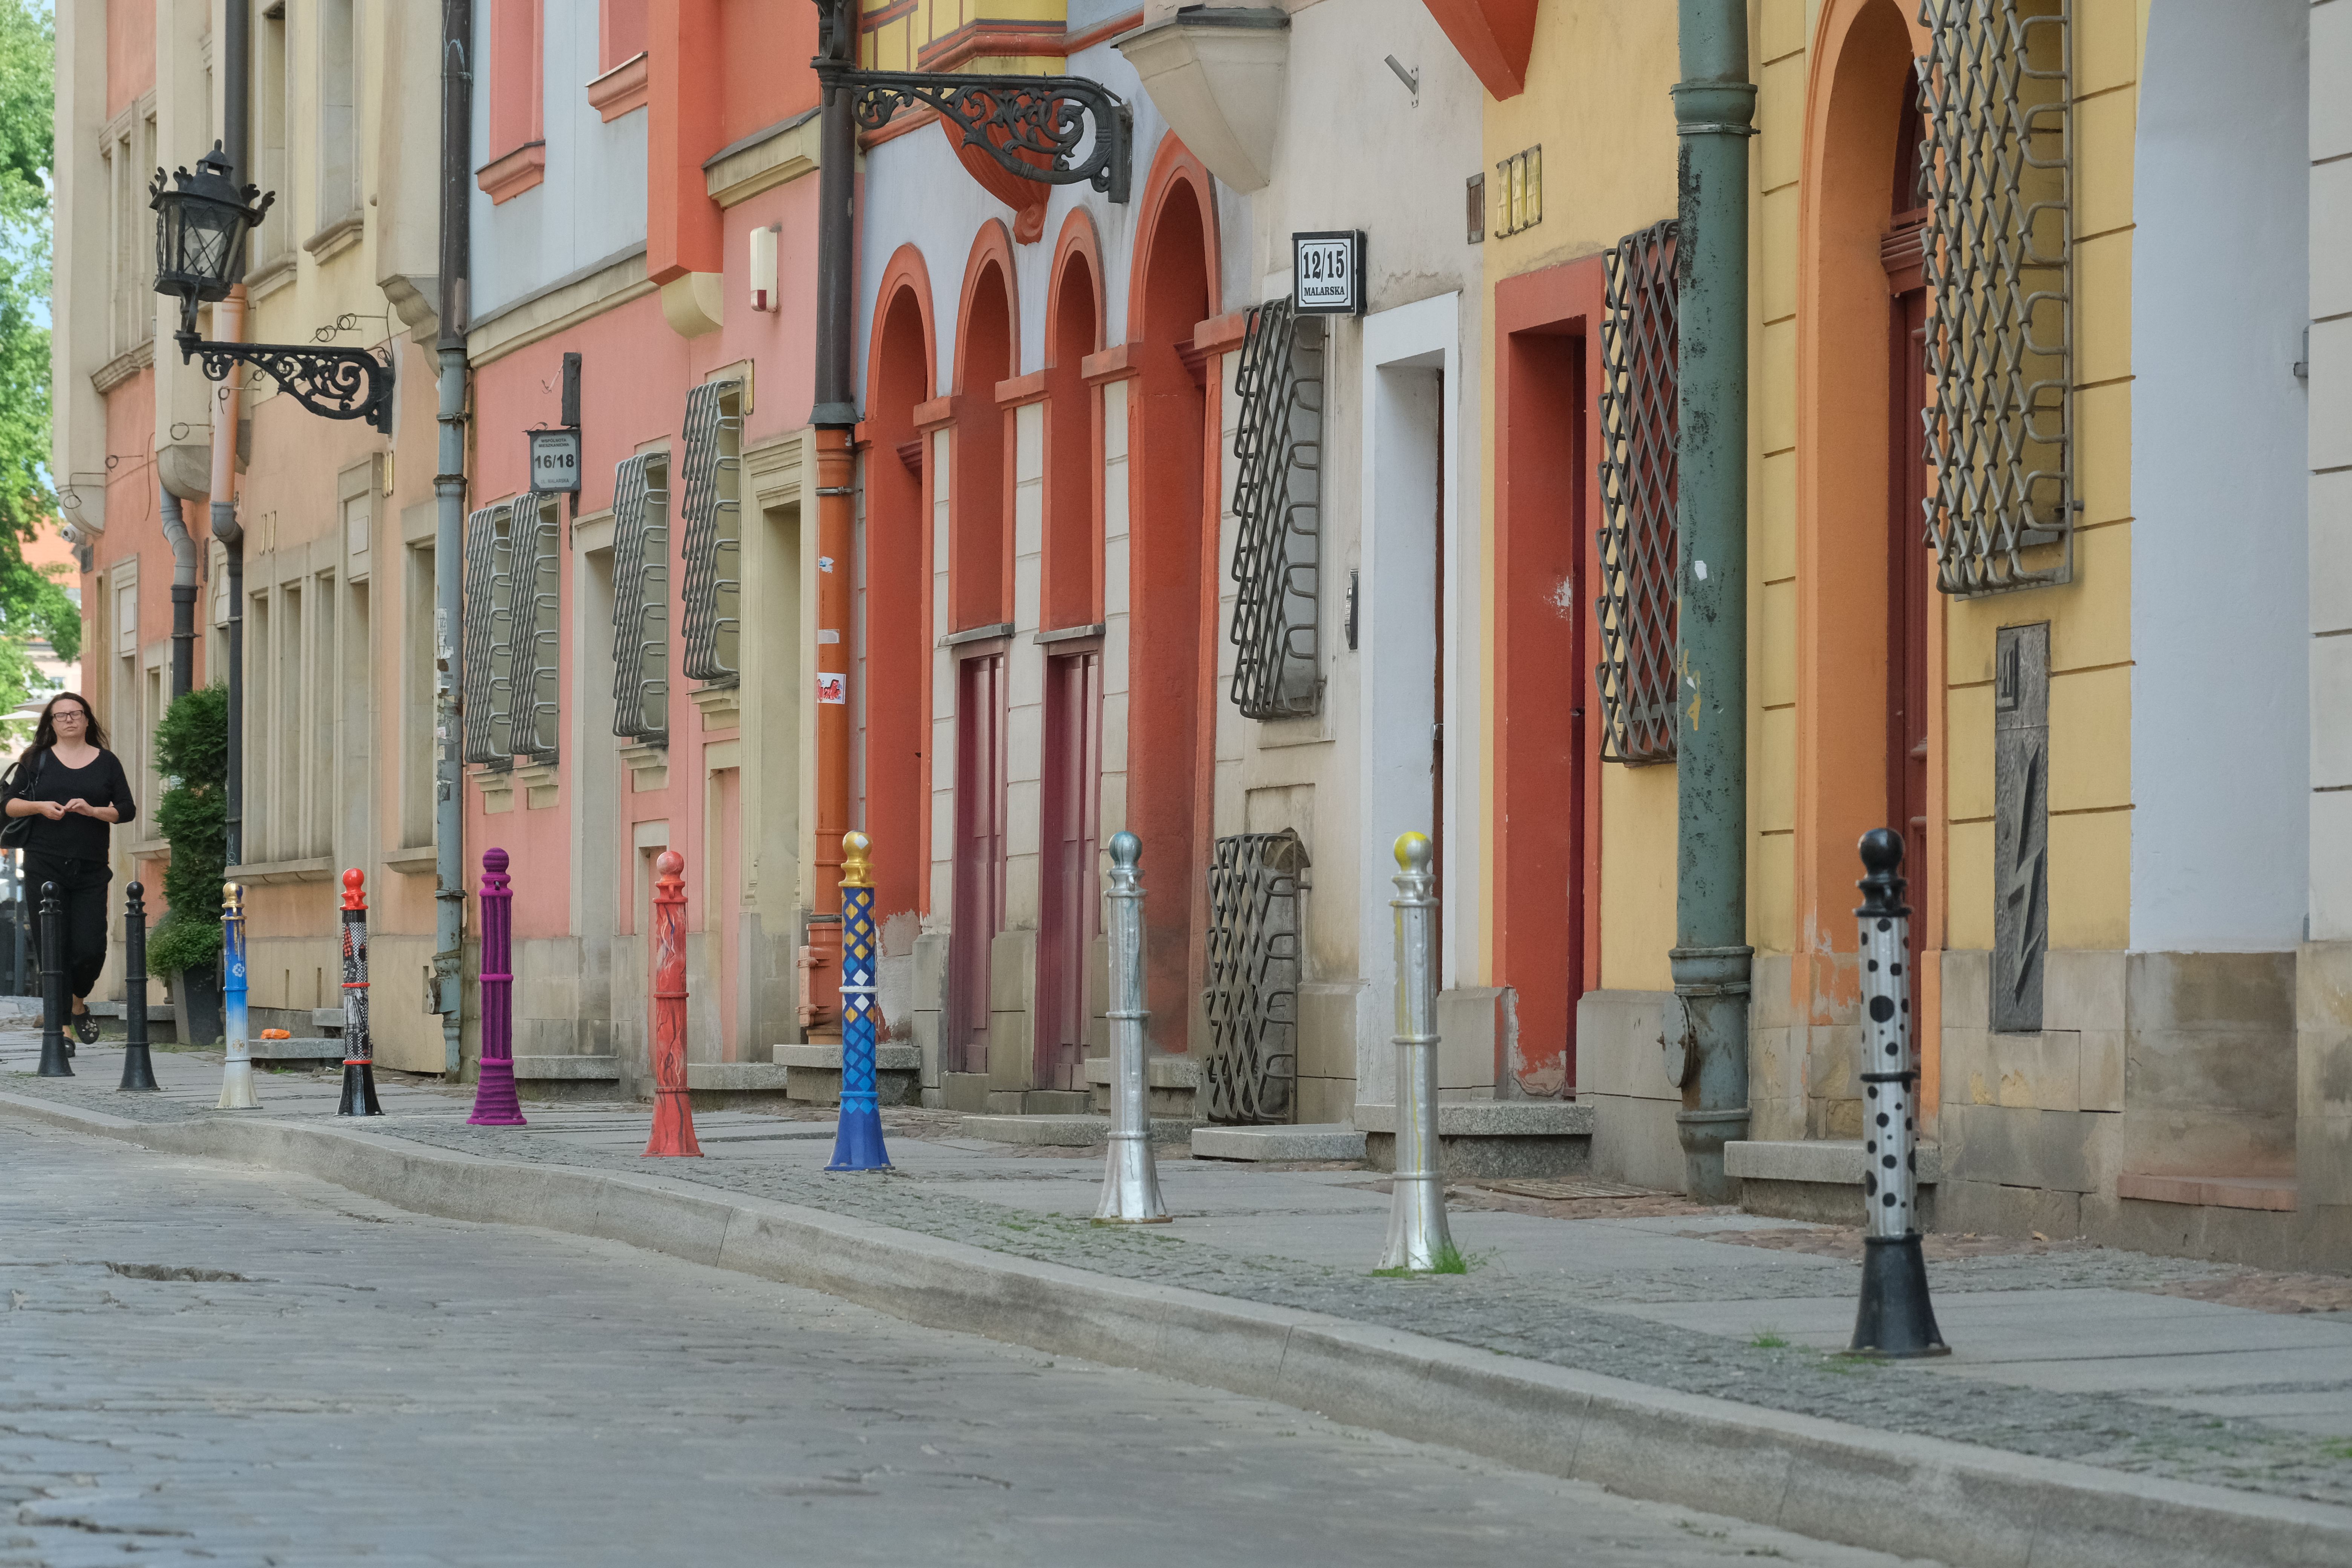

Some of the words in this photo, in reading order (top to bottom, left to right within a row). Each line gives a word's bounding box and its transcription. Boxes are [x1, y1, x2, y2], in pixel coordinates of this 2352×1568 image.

[1303, 247, 1344, 282] 12/15
[1304, 286, 1345, 296] MALARSKA
[534, 454, 574, 469] 16/18
